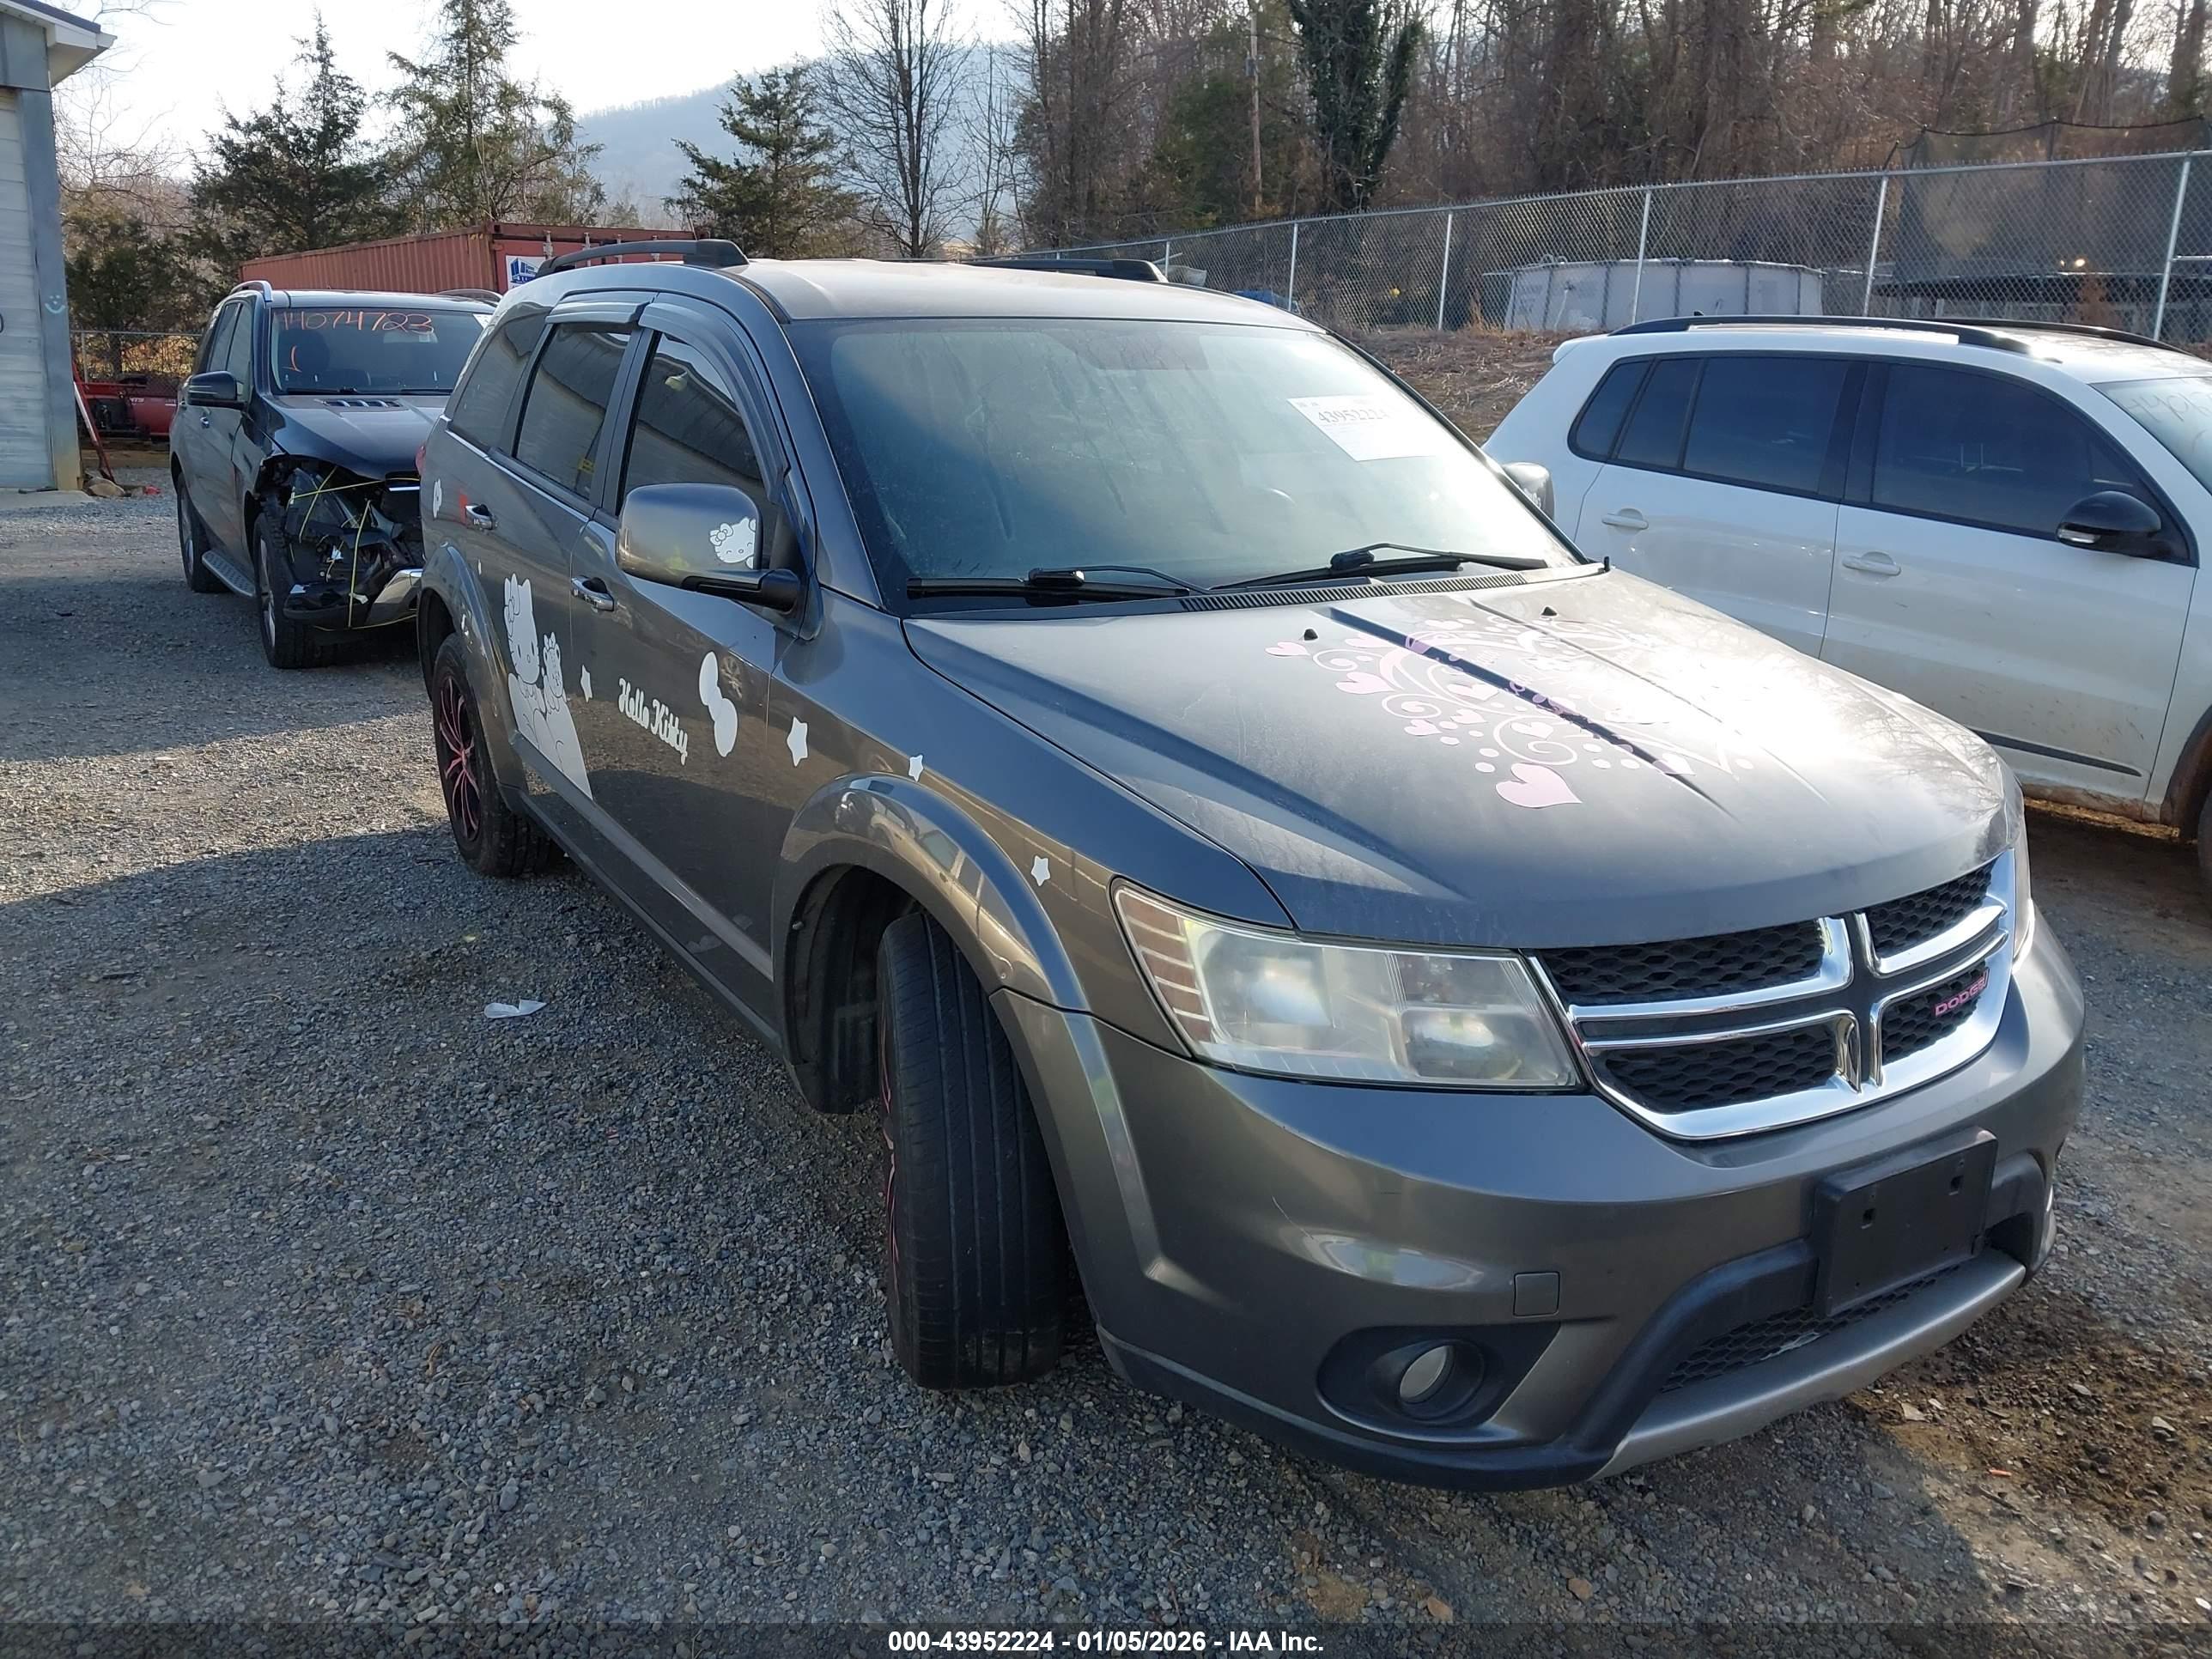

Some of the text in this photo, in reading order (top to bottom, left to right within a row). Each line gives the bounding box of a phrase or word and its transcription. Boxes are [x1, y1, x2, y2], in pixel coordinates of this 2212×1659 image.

[618, 678, 689, 766] Hello Kitty
[1935, 975, 1986, 1018] DODGE
